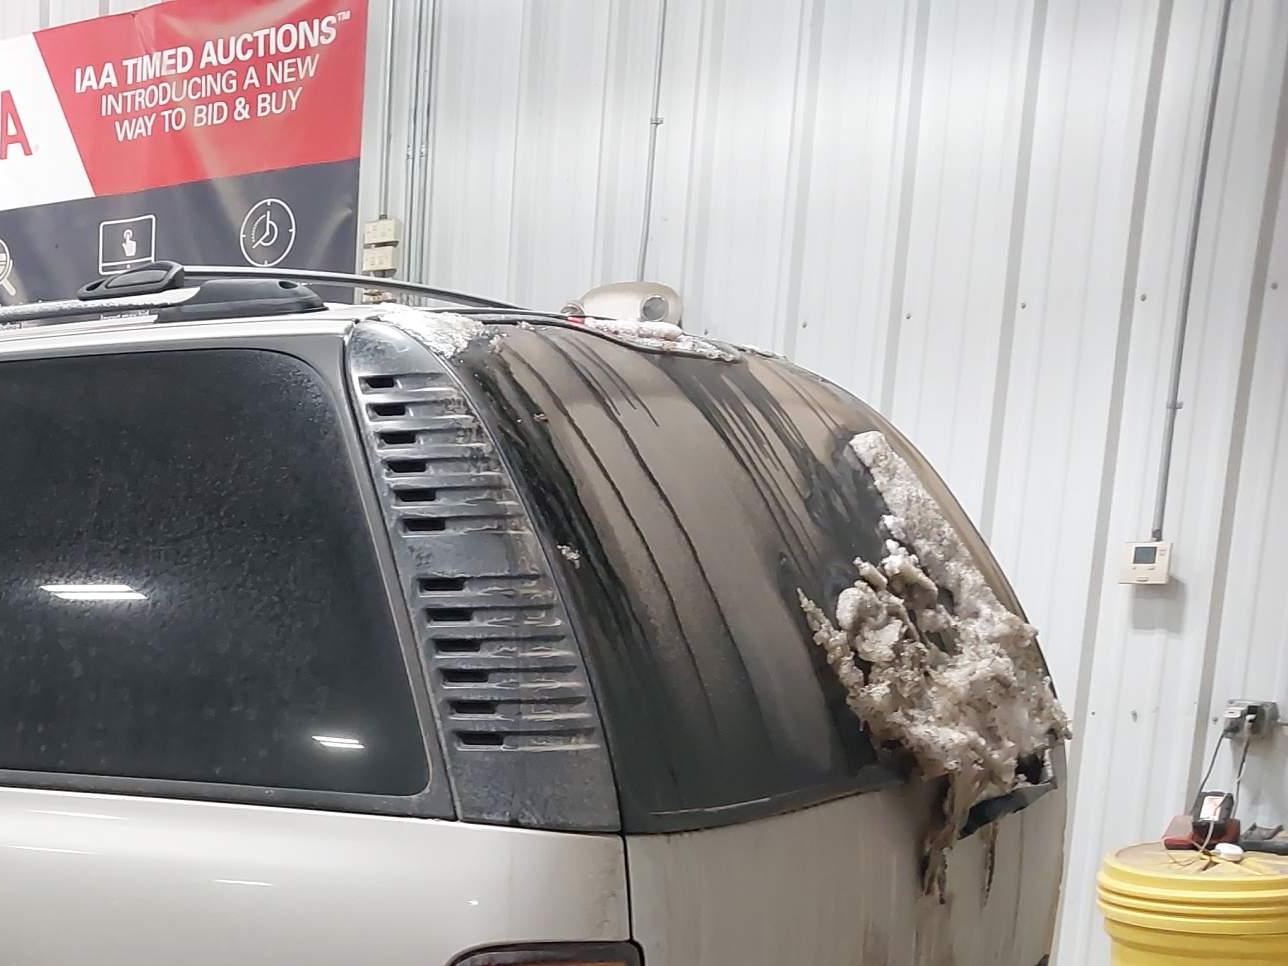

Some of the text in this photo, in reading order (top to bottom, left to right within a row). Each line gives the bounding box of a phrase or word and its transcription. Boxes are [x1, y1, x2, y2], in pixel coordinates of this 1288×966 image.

[75, 62, 118, 93] IAA
[122, 46, 194, 86] TIMED
[101, 54, 320, 116] INTRODUCING A NEW
[114, 87, 302, 142] WAY TO BID & BUY
